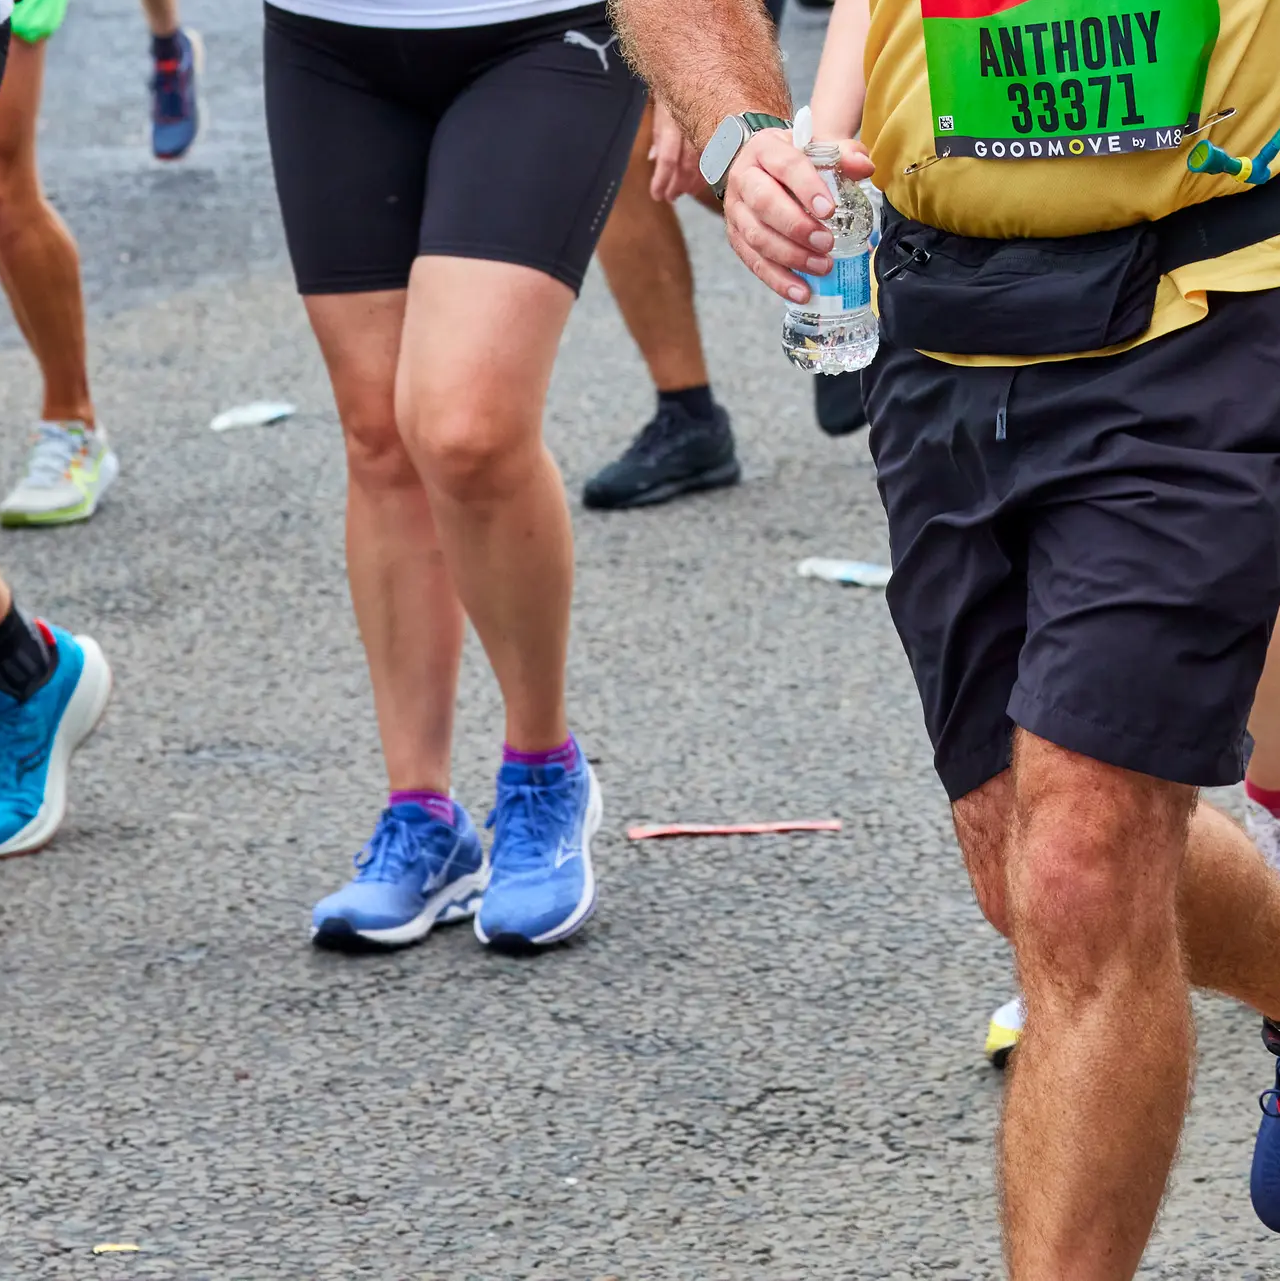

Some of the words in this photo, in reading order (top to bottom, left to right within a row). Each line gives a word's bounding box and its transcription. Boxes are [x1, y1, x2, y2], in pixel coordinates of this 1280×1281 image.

[979, 10, 1161, 78] ANTHONY
[1007, 73, 1145, 134] 33371
[974, 134, 1122, 158] GOODMOVE
[1132, 136, 1146, 149] by
